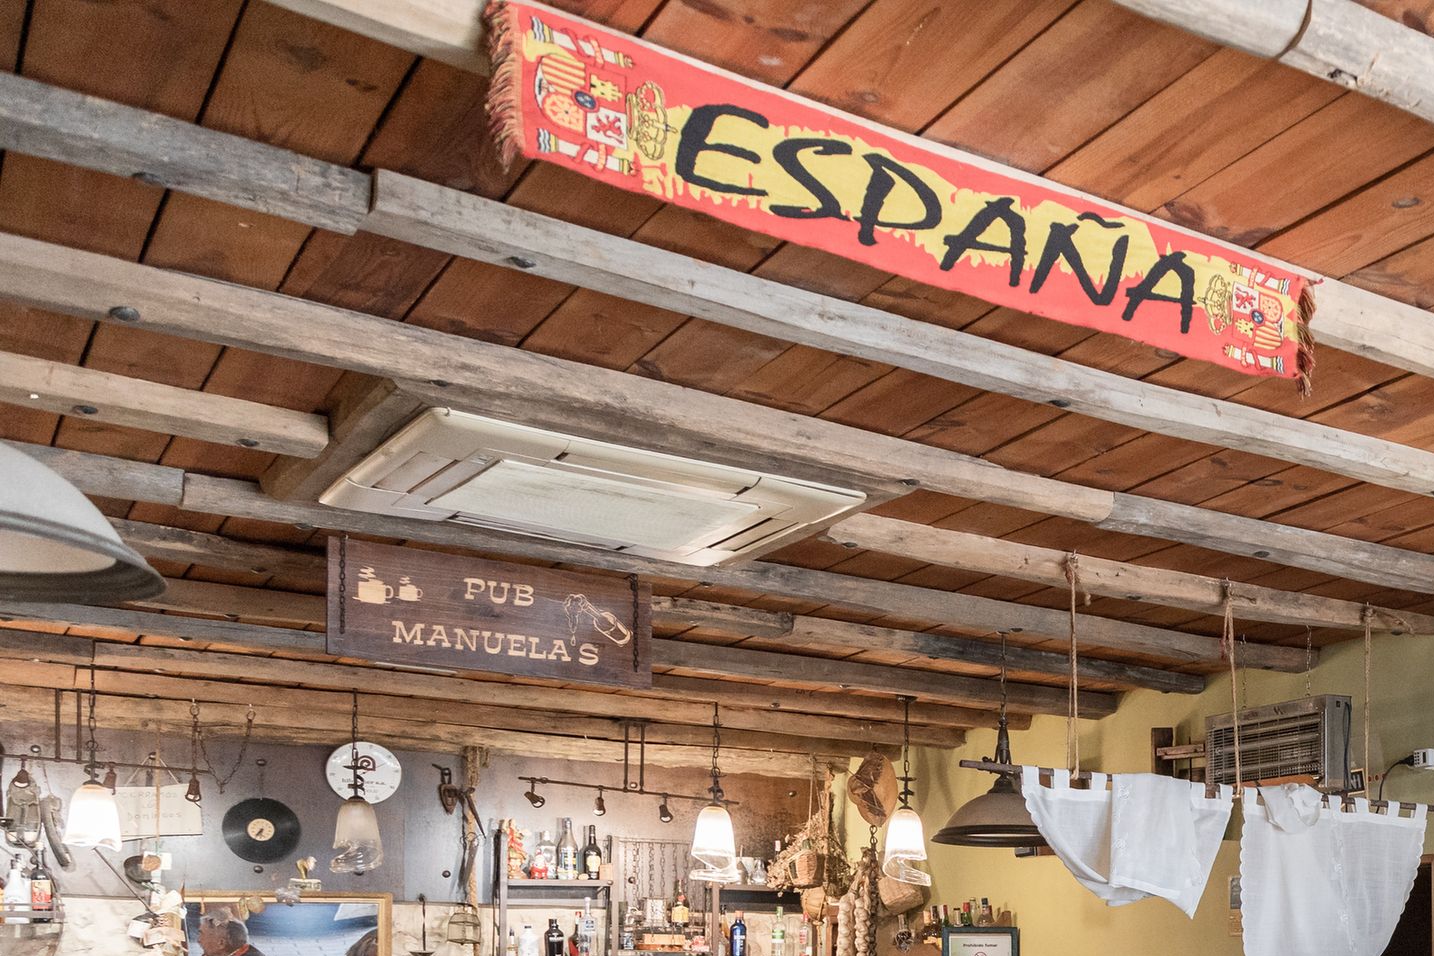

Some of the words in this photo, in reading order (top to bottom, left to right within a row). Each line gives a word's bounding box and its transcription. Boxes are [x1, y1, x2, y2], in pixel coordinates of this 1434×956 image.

[675, 105, 1197, 334] ESPAÑA
[463, 577, 535, 607] PUB
[392, 620, 600, 666] MANUELA'S
